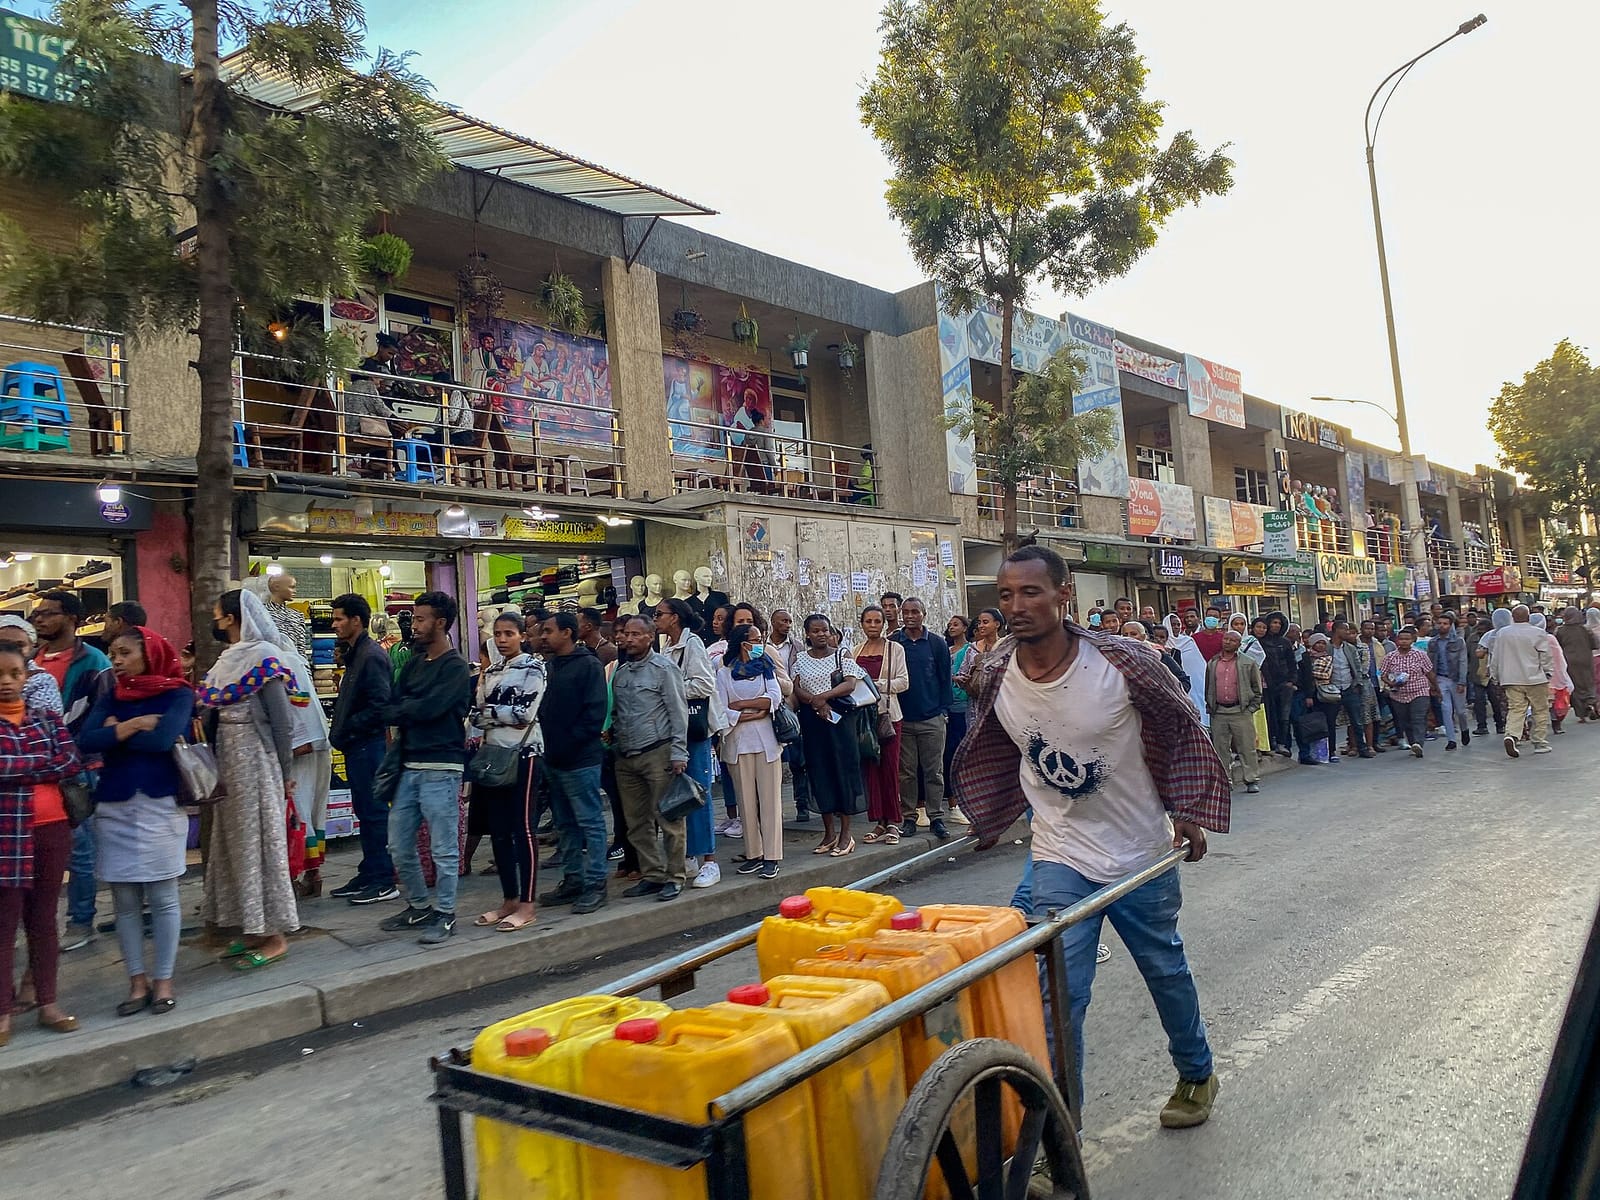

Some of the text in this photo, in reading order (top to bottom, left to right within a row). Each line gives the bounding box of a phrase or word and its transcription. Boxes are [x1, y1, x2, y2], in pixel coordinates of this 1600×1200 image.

[26, 63, 49, 81] 57
[26, 80, 49, 97] 57
[1115, 356, 1176, 386] Entrance
[1130, 479, 1154, 501] Yona
[1161, 550, 1184, 568] Lina
